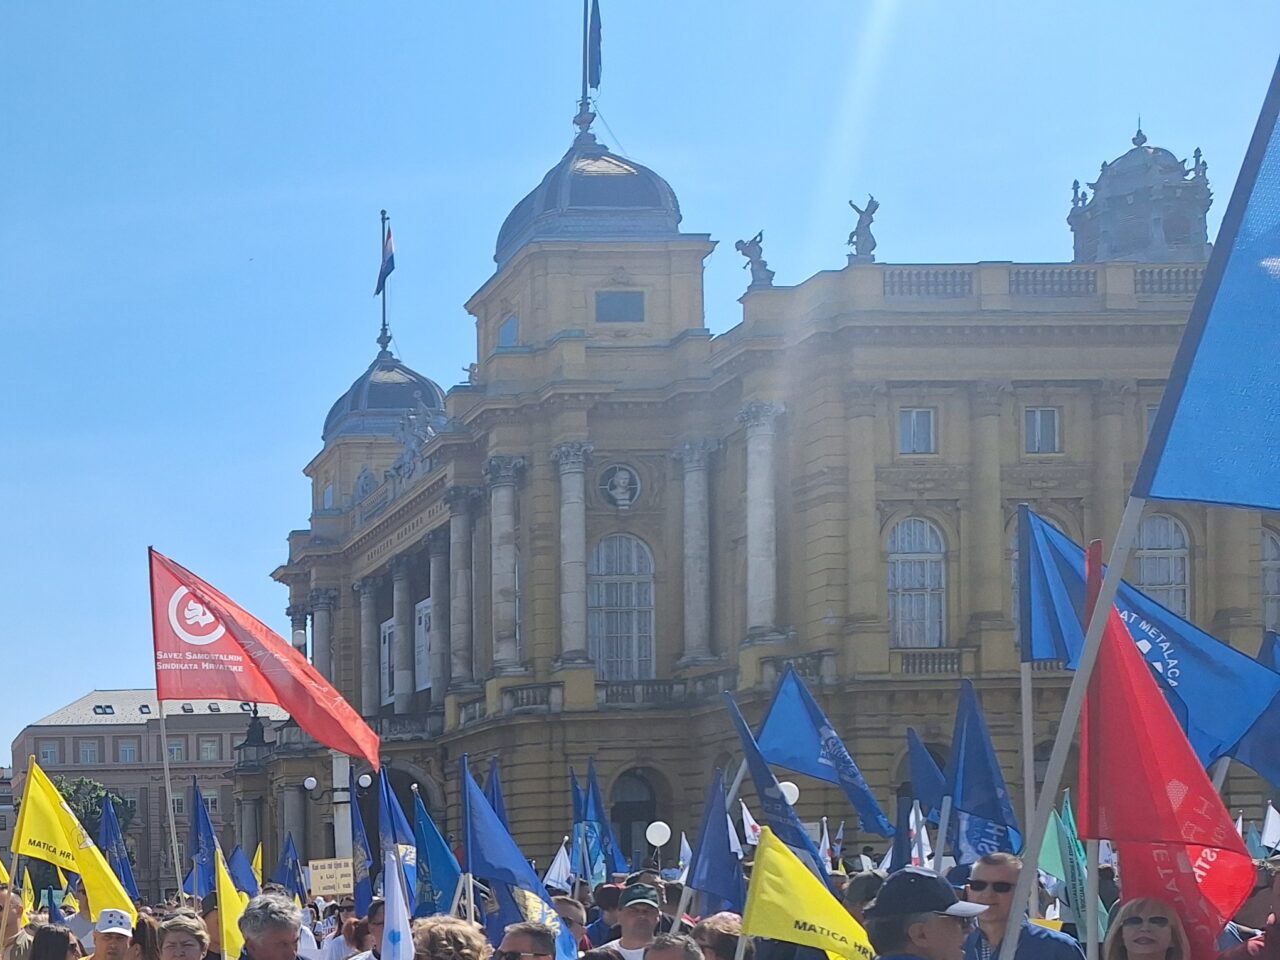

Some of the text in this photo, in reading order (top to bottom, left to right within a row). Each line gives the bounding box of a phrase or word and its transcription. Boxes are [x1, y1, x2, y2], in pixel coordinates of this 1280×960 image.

[157, 650, 183, 659] SAVEZ
[157, 661, 198, 670] SINDIKATA
[28, 838, 57, 855] MATICA
[793, 919, 848, 945] MATICA
